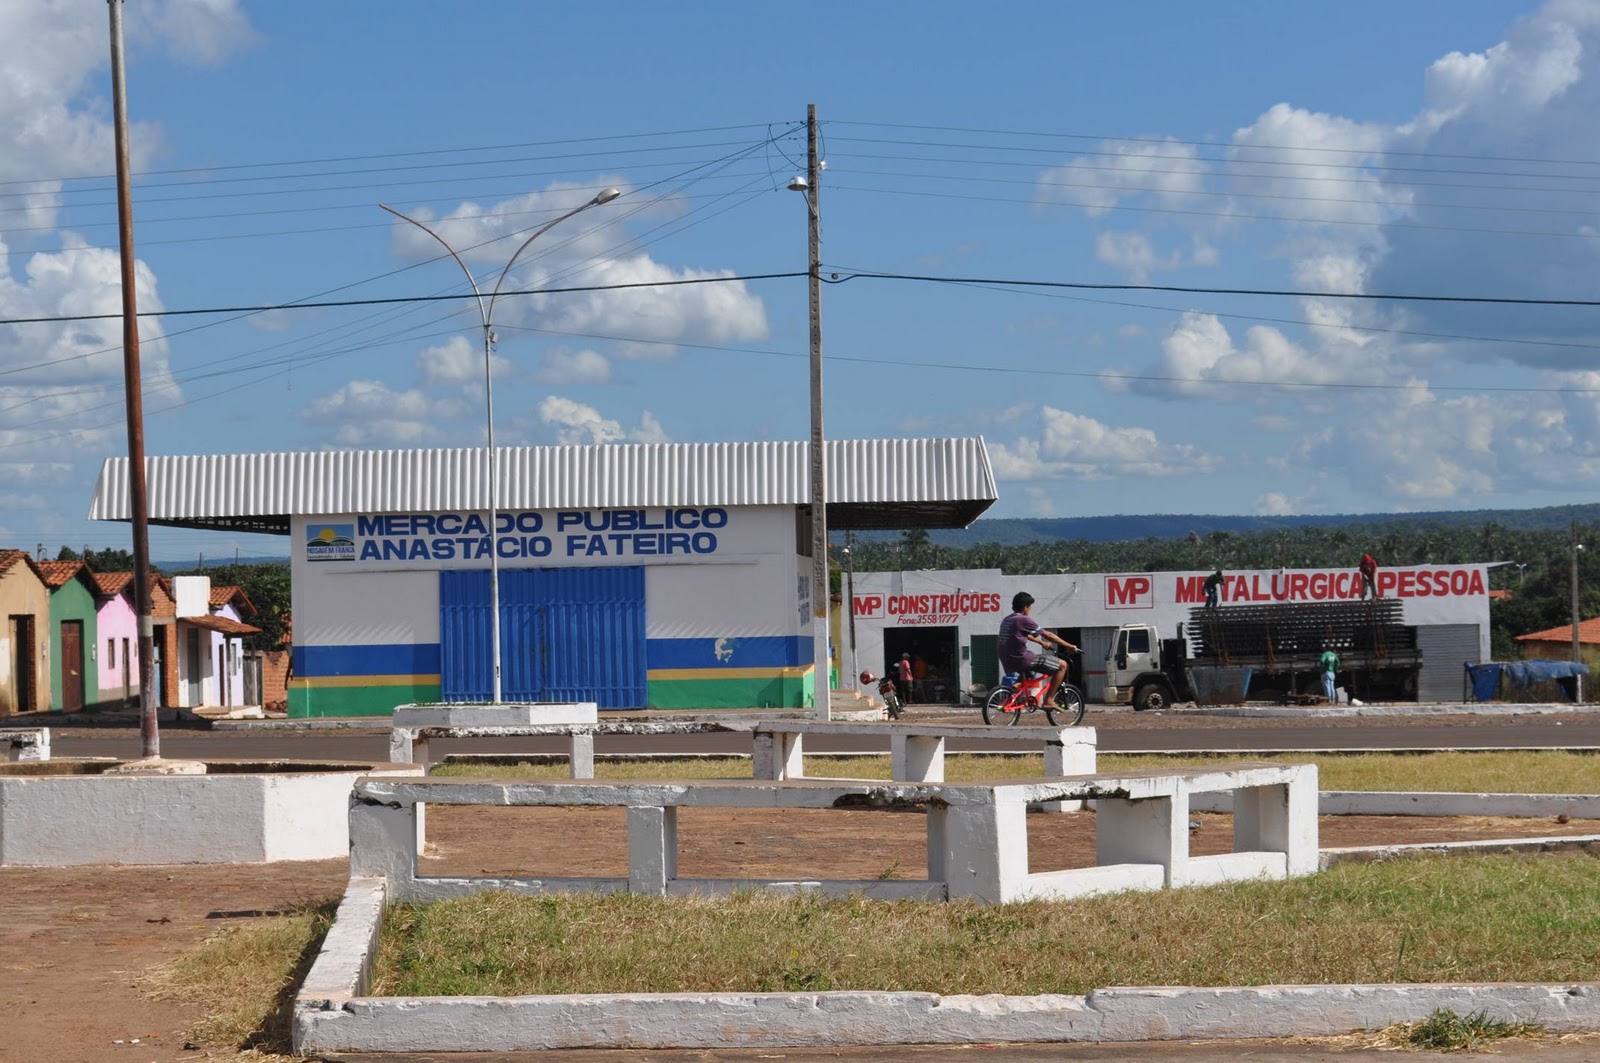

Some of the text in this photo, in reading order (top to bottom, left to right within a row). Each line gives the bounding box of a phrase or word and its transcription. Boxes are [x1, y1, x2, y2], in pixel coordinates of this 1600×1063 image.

[357, 512, 544, 536] MERCADO
[359, 532, 718, 561] ANASTÁCIO FATEIRO
[1107, 577, 1150, 605] MP
[1377, 569, 1485, 598] PESSOA
[853, 591, 1001, 616] MP CONSTRUÇÕES
